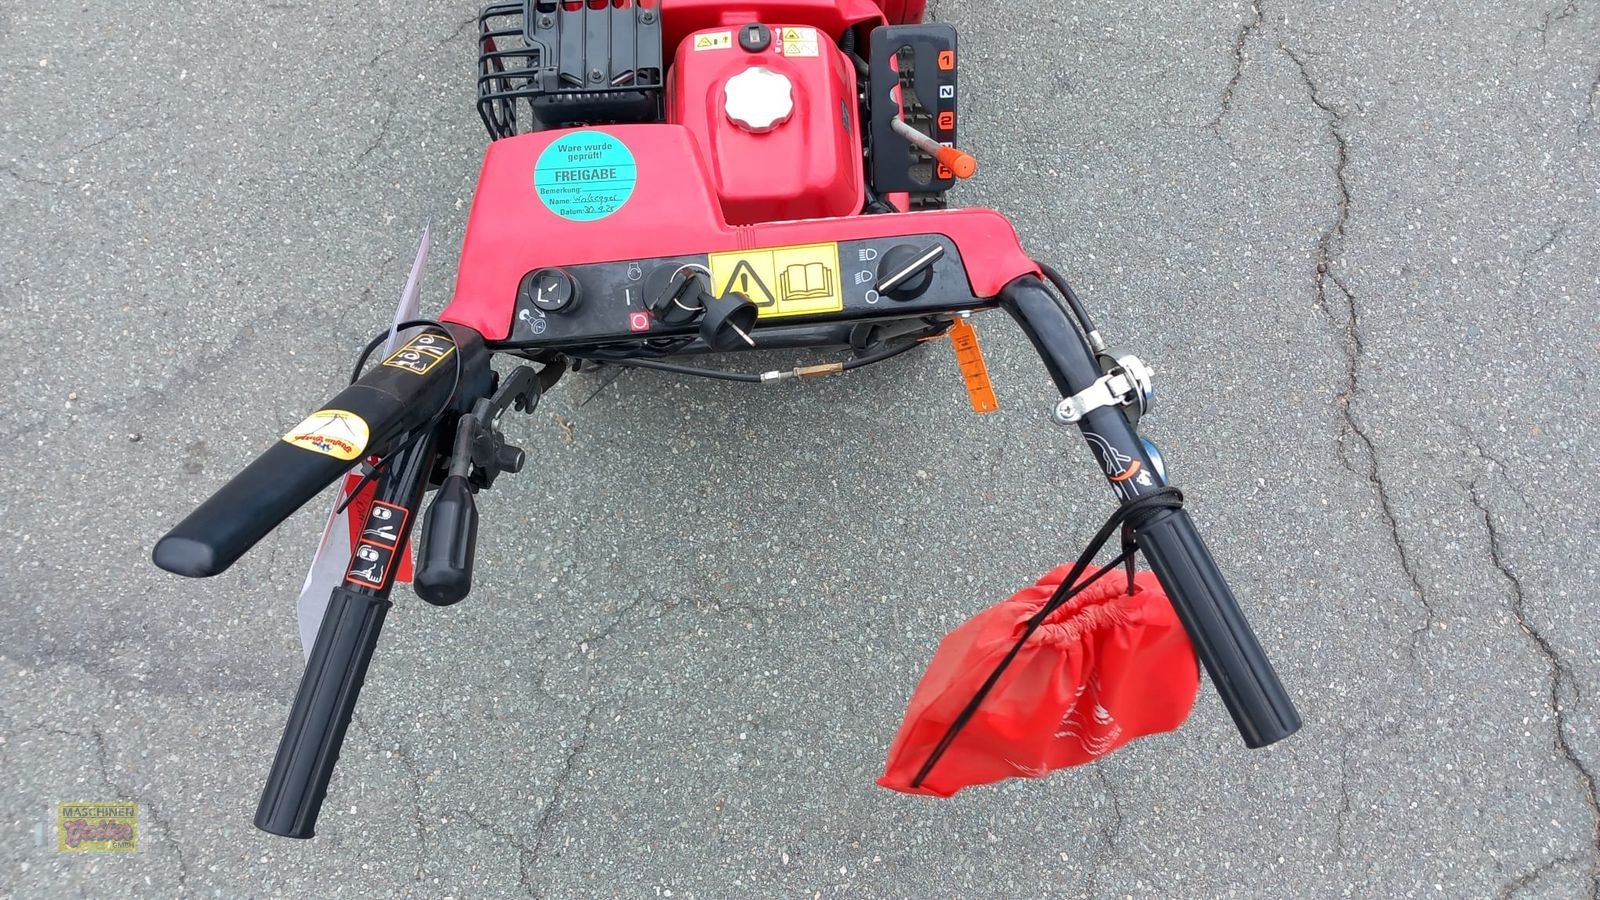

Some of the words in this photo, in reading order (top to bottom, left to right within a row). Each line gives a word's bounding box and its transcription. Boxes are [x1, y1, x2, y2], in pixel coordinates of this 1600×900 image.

[942, 55, 951, 66] 1
[941, 87, 952, 97] N
[940, 115, 952, 126] 2
[558, 144, 582, 152] Ware
[584, 142, 612, 151] wurde
[567, 151, 602, 162] geprüft!
[555, 168, 617, 182] FREIGABE
